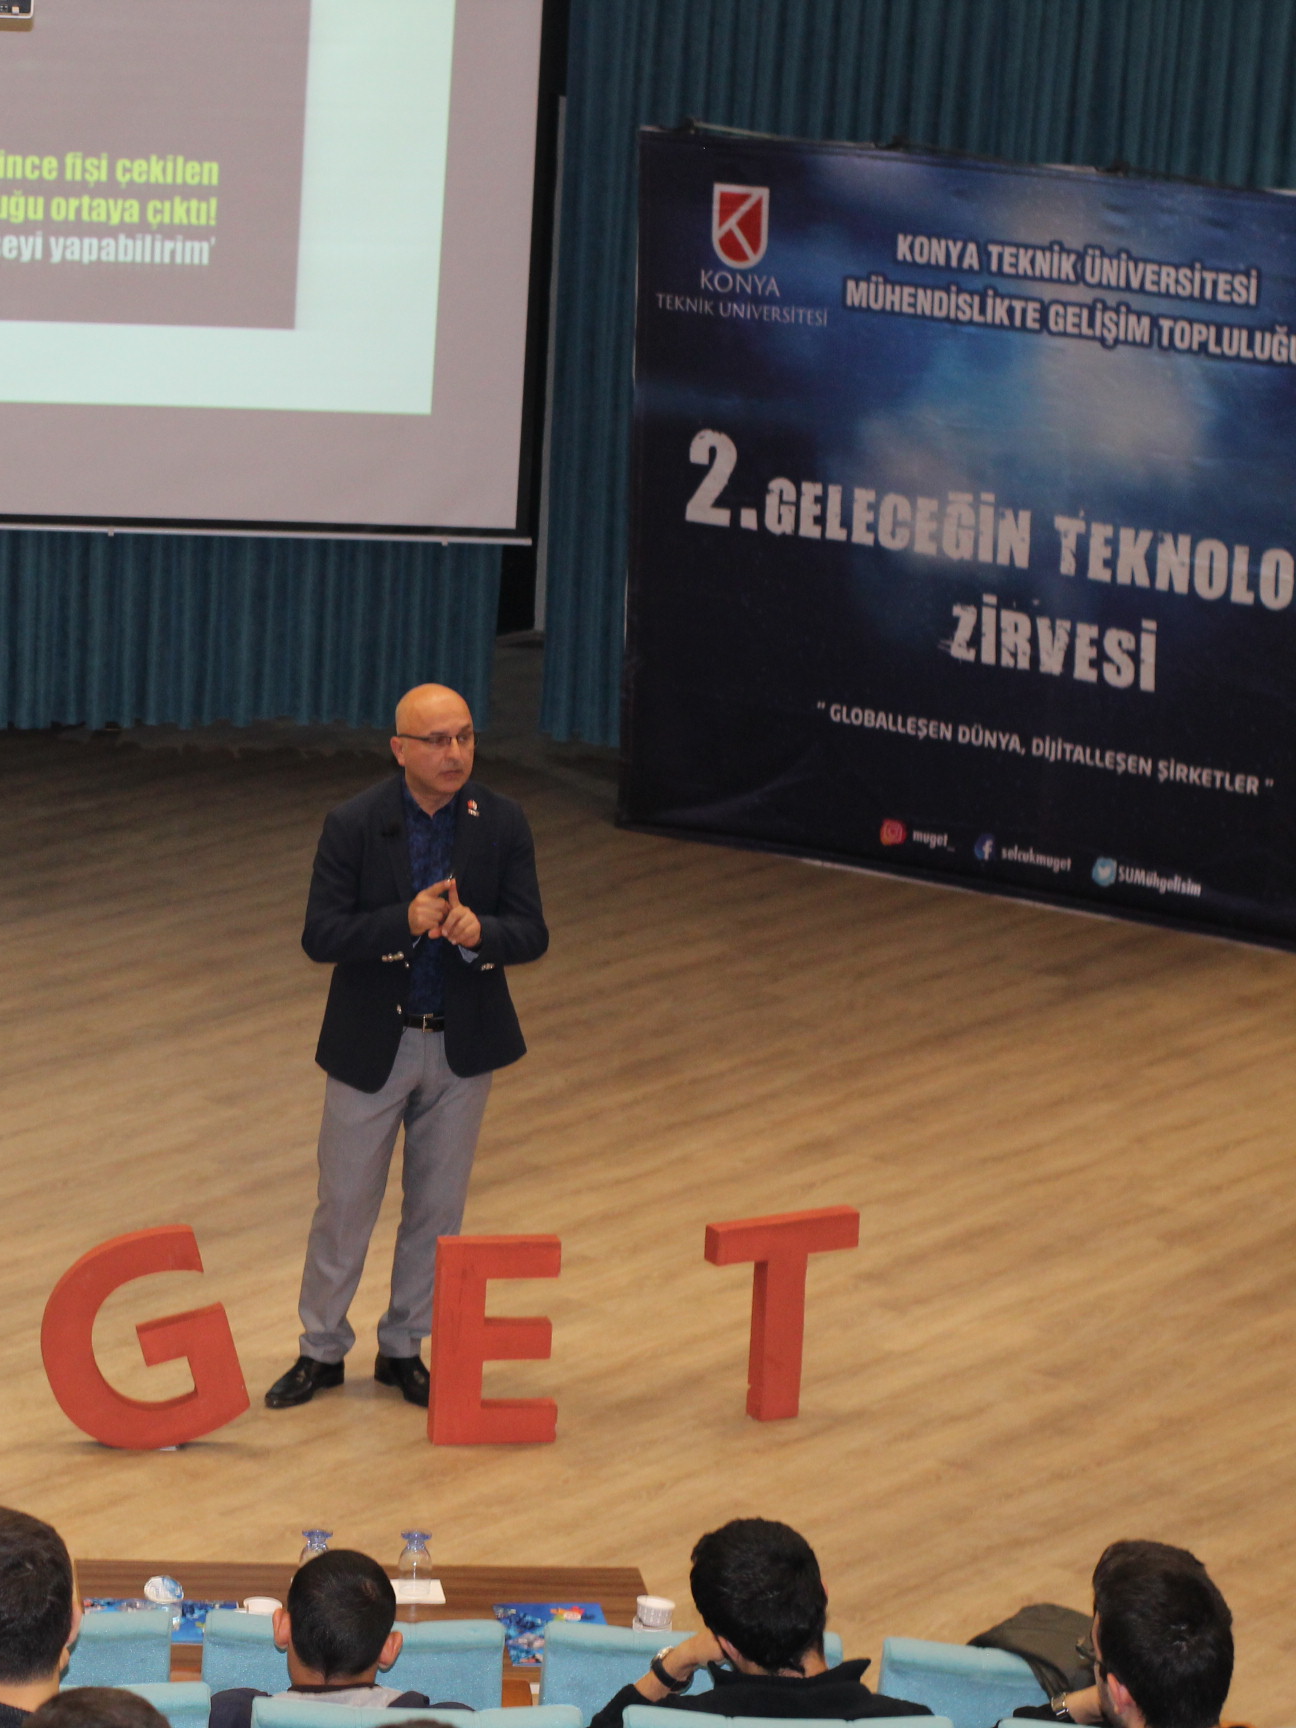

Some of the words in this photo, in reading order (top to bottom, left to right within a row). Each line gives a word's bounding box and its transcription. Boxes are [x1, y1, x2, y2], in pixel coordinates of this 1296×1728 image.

[65, 152, 108, 188] fişi
[116, 154, 219, 189] çekilen
[50, 194, 140, 225] ortaya
[146, 195, 217, 230] çıktı!
[700, 268, 781, 297] KONYA
[896, 234, 980, 271] KONYA
[988, 244, 1077, 282] TEKNİK
[1084, 248, 1257, 306] ÜNİVERSİTESİ
[656, 292, 714, 316] TEKNİK
[846, 274, 1041, 330] MÜHENDİSLİKTE
[1048, 302, 1151, 346] GELİŞİM
[949, 593, 1158, 693] ZİRVESİ
[958, 723, 1025, 756] DÜNYA,
